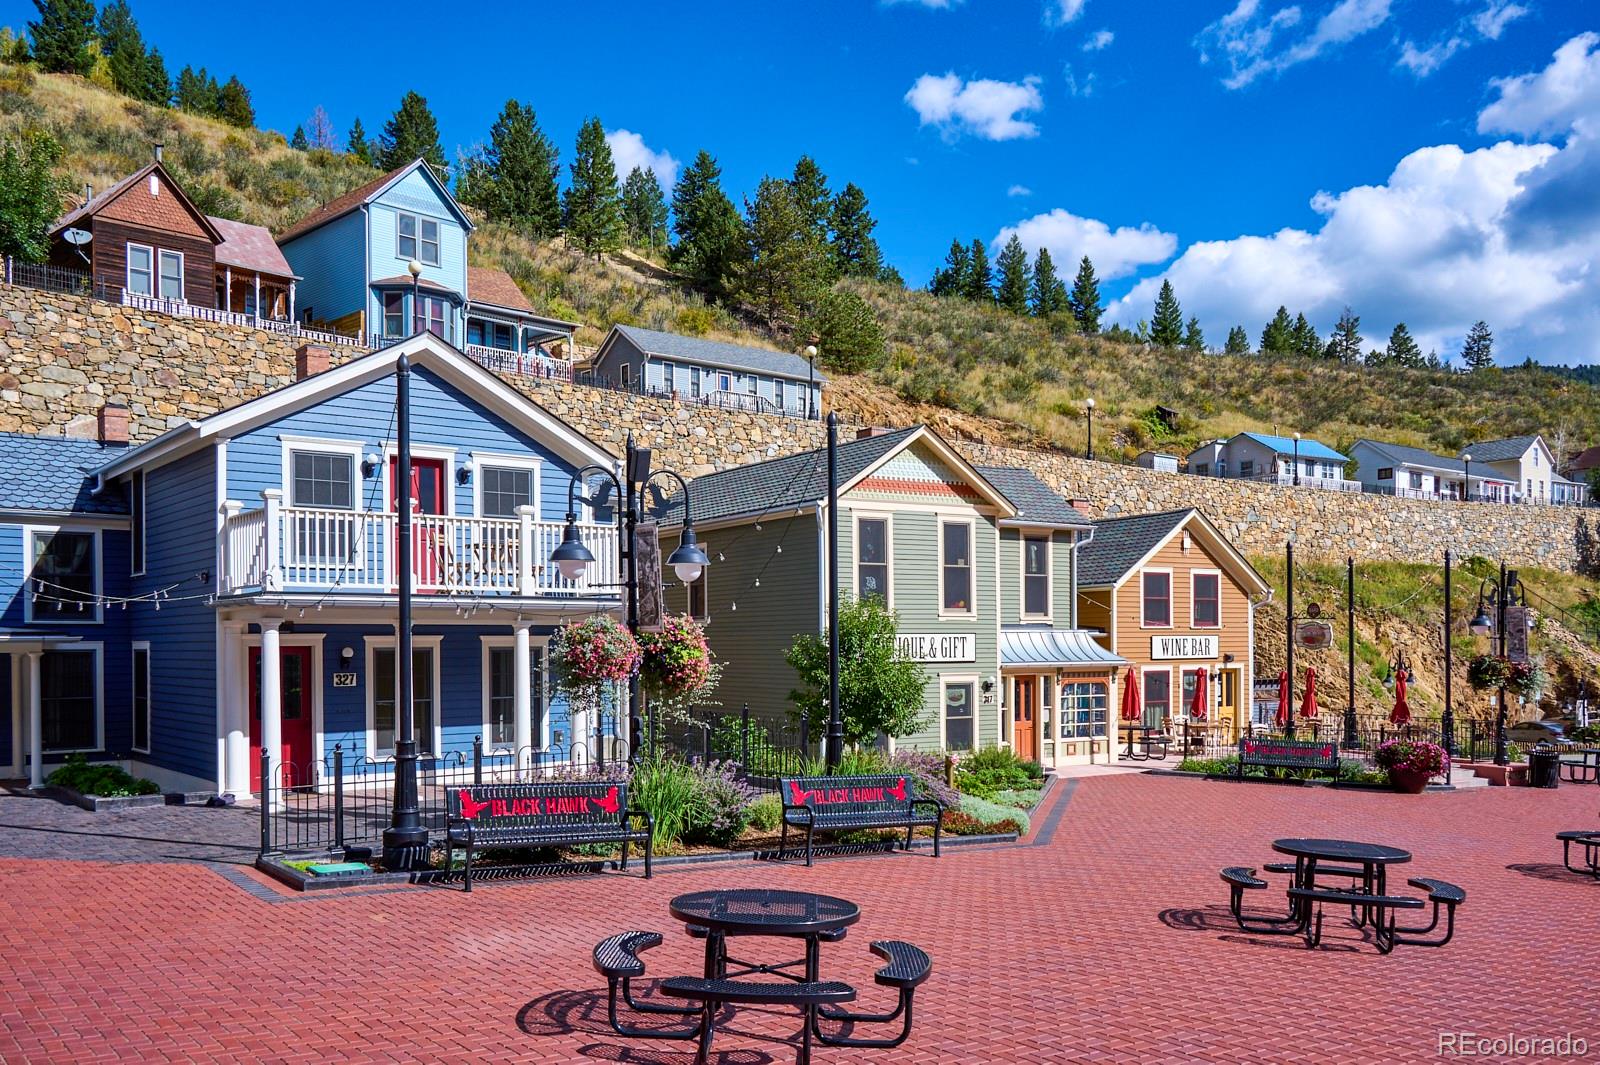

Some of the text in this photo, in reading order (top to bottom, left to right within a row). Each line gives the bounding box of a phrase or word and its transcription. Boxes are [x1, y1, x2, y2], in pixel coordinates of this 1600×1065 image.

[928, 636, 937, 658] &
[941, 636, 967, 658] GIFT
[1161, 637, 1211, 656] WINE BAR
[335, 673, 355, 685] 327
[814, 787, 885, 804] BLACK HAWK
[491, 796, 590, 817] BLACK HAWK
